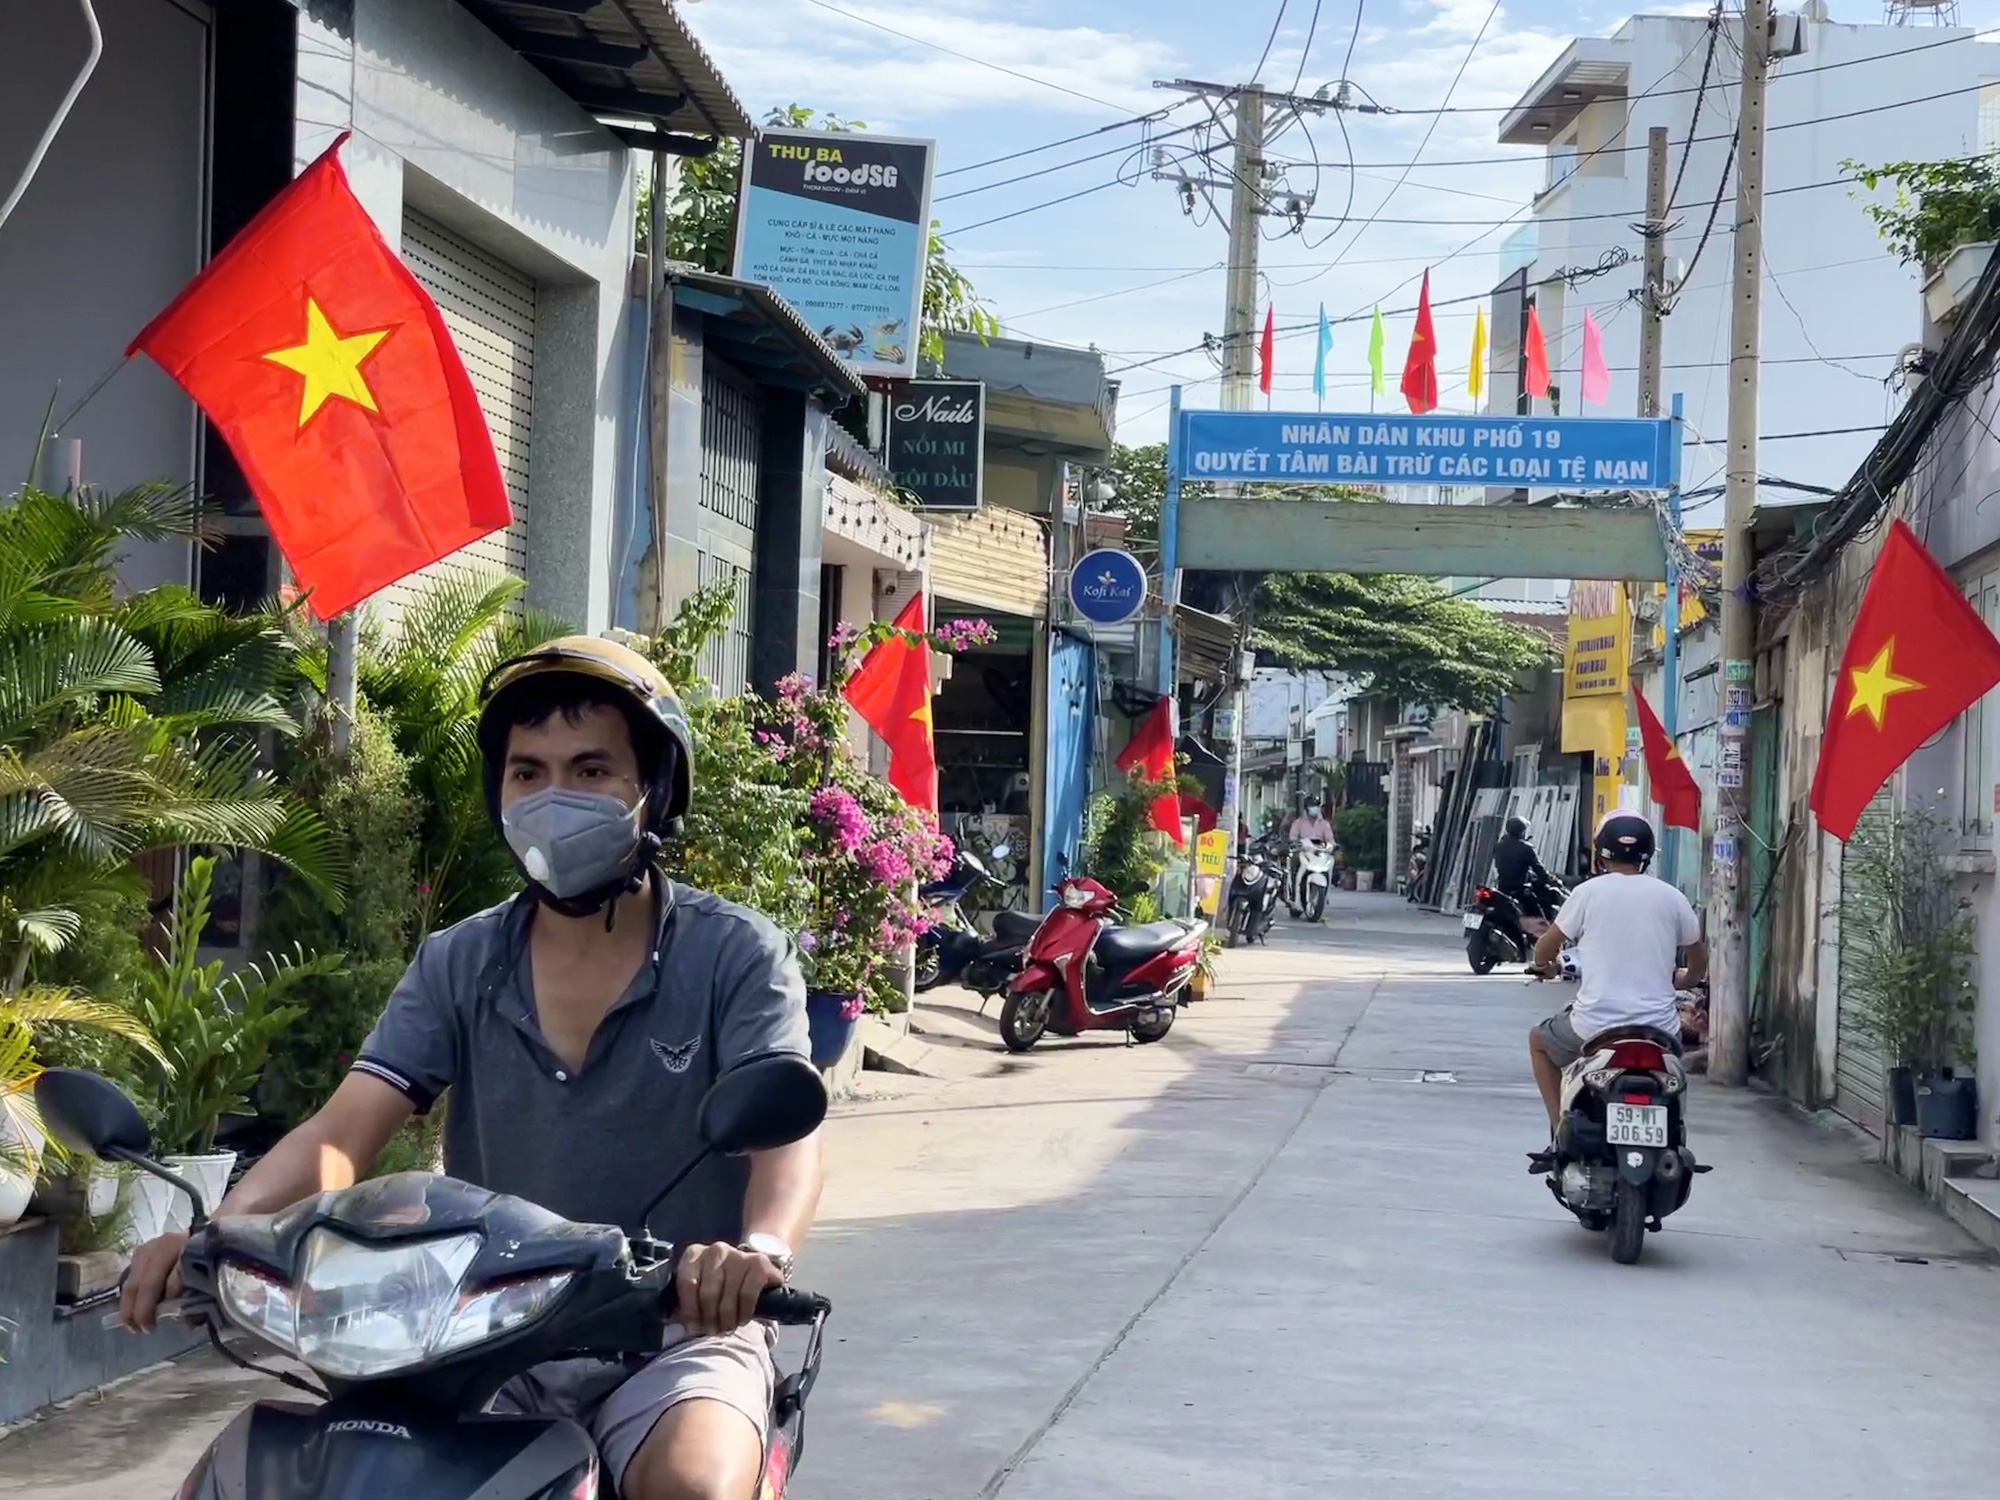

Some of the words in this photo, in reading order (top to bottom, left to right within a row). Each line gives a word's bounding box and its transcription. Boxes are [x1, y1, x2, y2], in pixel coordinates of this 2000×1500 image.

[768, 144, 810, 160] THU
[816, 147, 843, 163] BA
[803, 160, 898, 188] foodSG
[767, 218, 790, 228] CUNG
[895, 395, 975, 424] Nails
[1281, 422, 1350, 445] NHÂN
[1357, 423, 1409, 446] DÂN
[1416, 426, 1465, 448] KHU
[1473, 423, 1523, 449] PHỐ
[1531, 430, 1561, 449] 19
[1194, 447, 1271, 474] QUYẾT
[1277, 450, 1329, 473] TÂM
[1336, 451, 1378, 475] BÀI
[1385, 452, 1434, 476] TRỪ
[1438, 453, 1488, 477] CÁC
[1496, 457, 1550, 482] LOẠI
[1558, 456, 1587, 483] TỆ
[1594, 460, 1649, 484] NẠN
[1610, 1124, 1664, 1144] 306.59
[325, 1420, 412, 1439] HONDA
